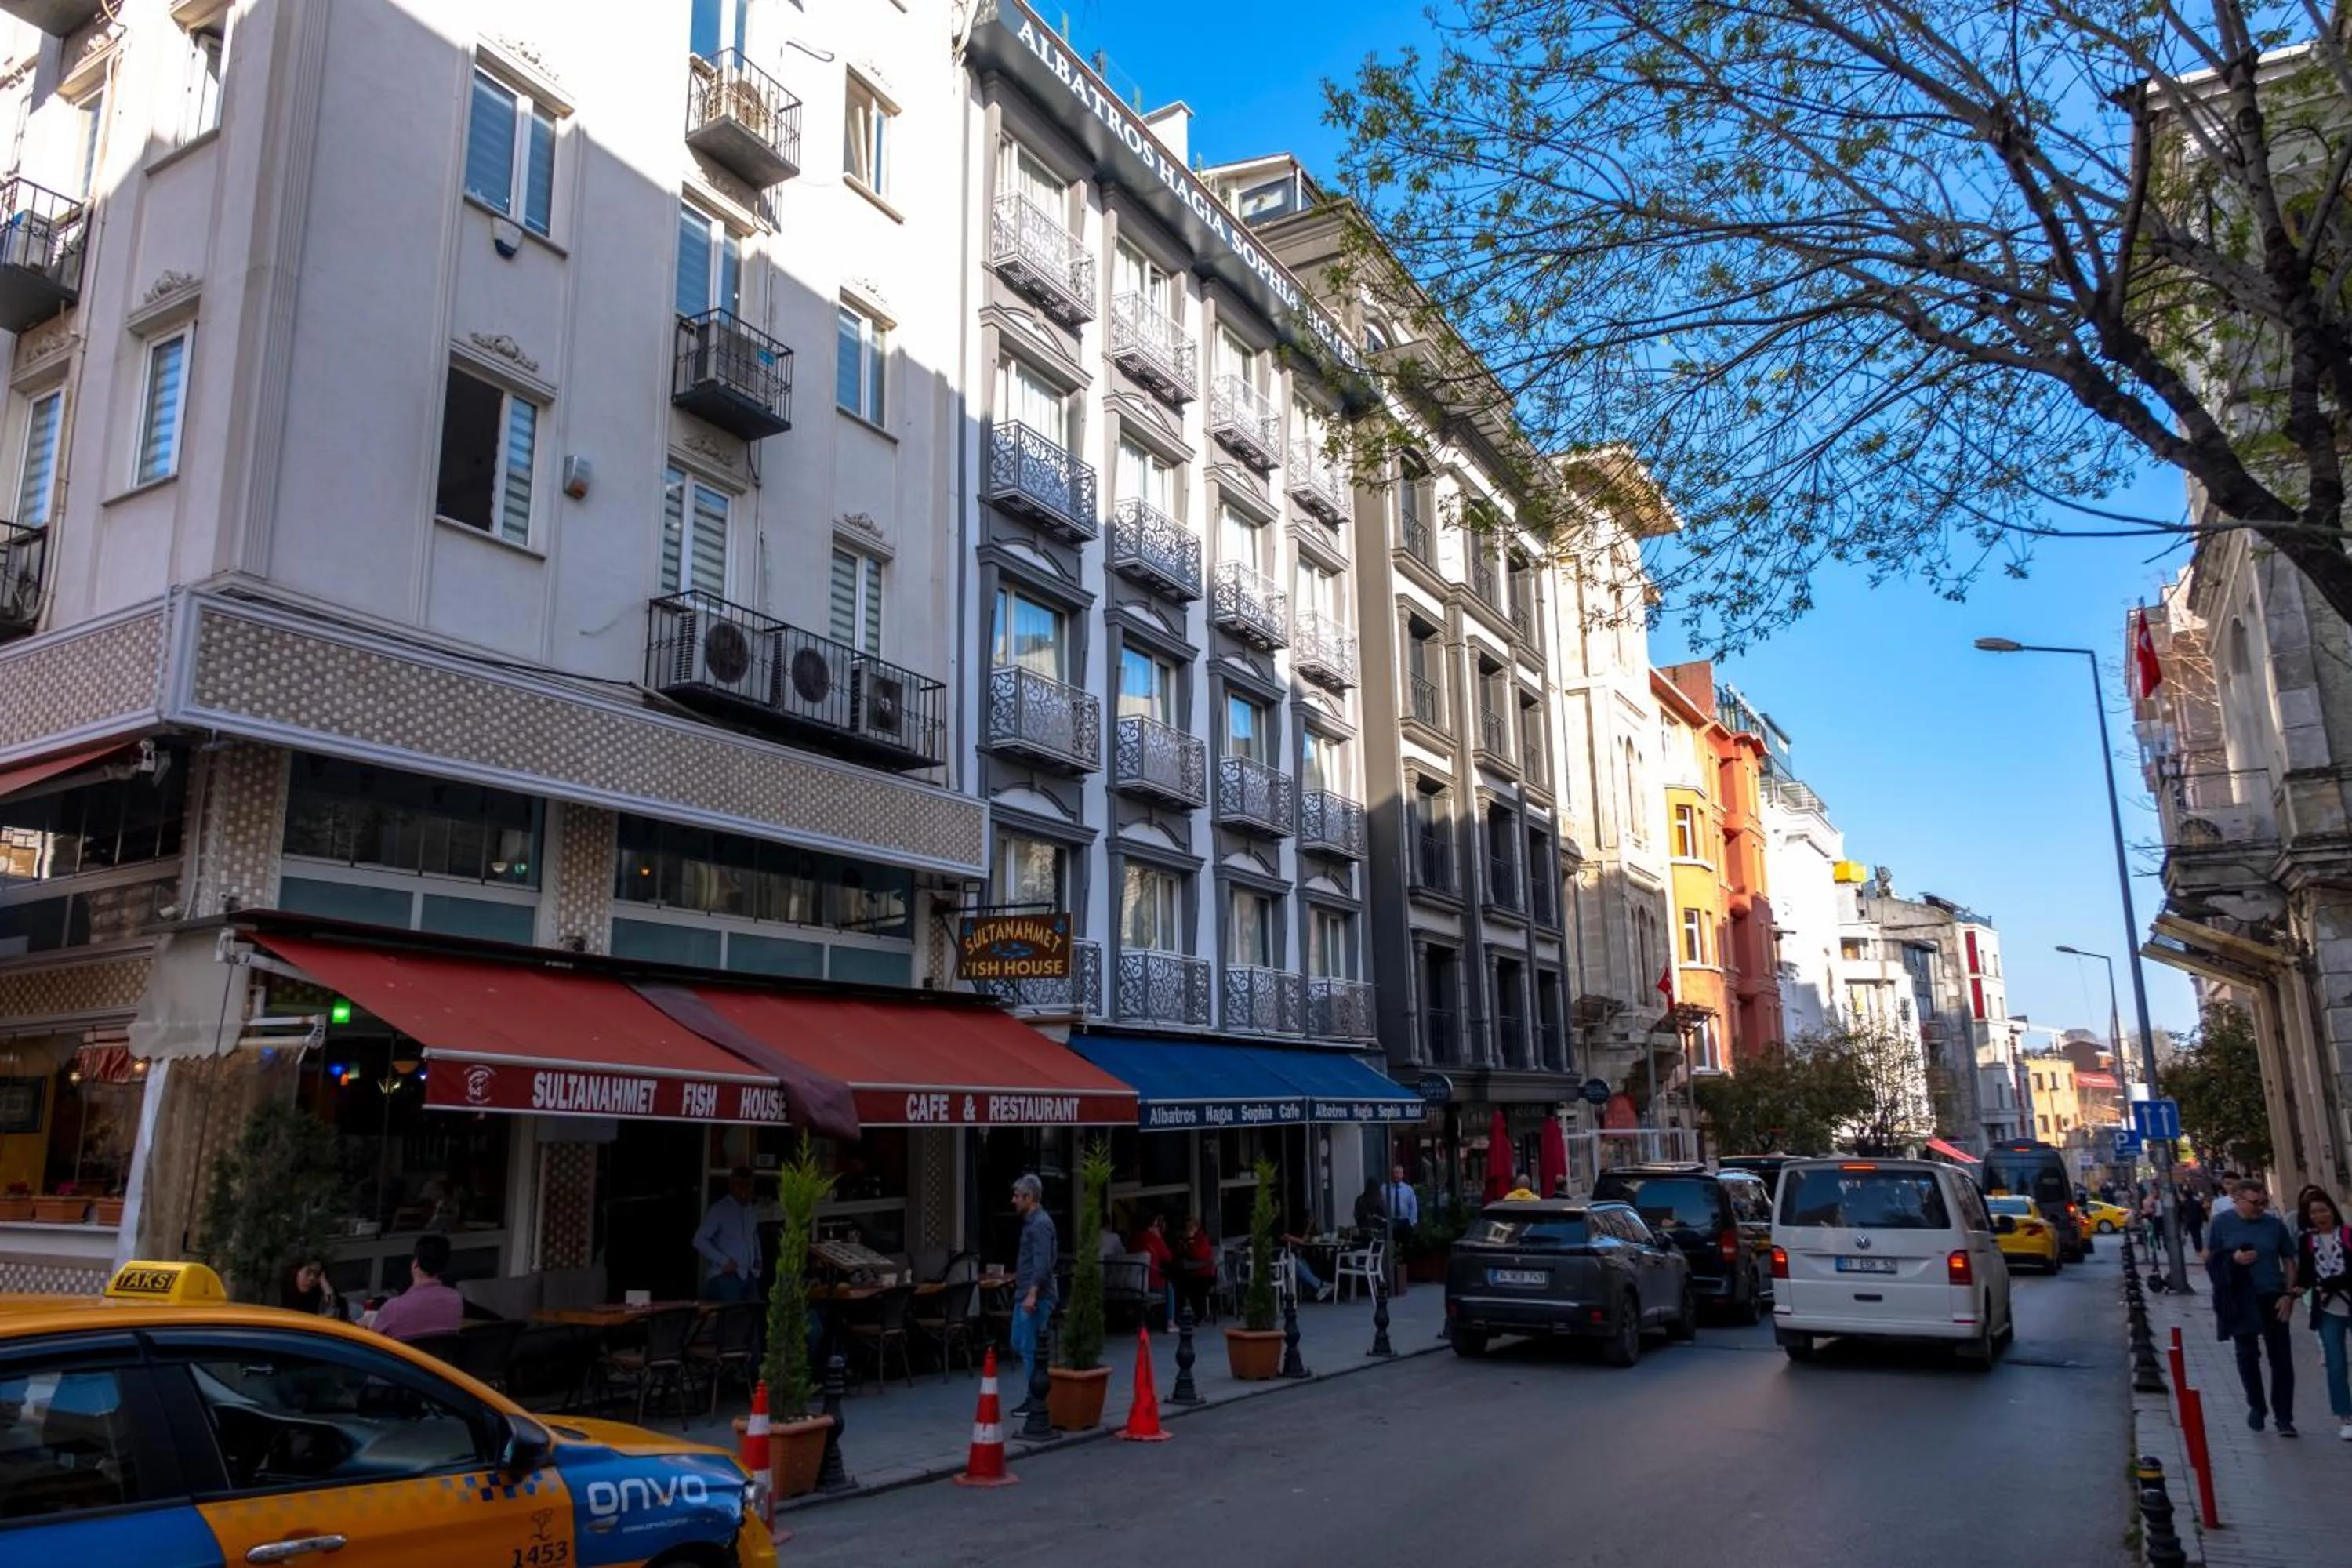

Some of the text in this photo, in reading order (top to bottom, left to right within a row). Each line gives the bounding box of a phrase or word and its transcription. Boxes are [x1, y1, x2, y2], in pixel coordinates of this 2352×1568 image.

[1017, 20, 1154, 168] ALBATROS
[965, 920, 1062, 955] SULTANAHMET
[1004, 960, 1064, 975] HOUSE
[533, 1072, 657, 1113] SULTANAHMET
[681, 1083, 717, 1117] FISH
[906, 1094, 1080, 1121] CAFE & RESTAURANT
[1150, 1105, 1196, 1125] Albatros
[1241, 1104, 1272, 1123] Sophia
[1279, 1103, 1301, 1120] Cafe
[1315, 1103, 1348, 1118] Albatros
[2114, 1133, 2129, 1150] P
[513, 1540, 568, 1568] 1453
